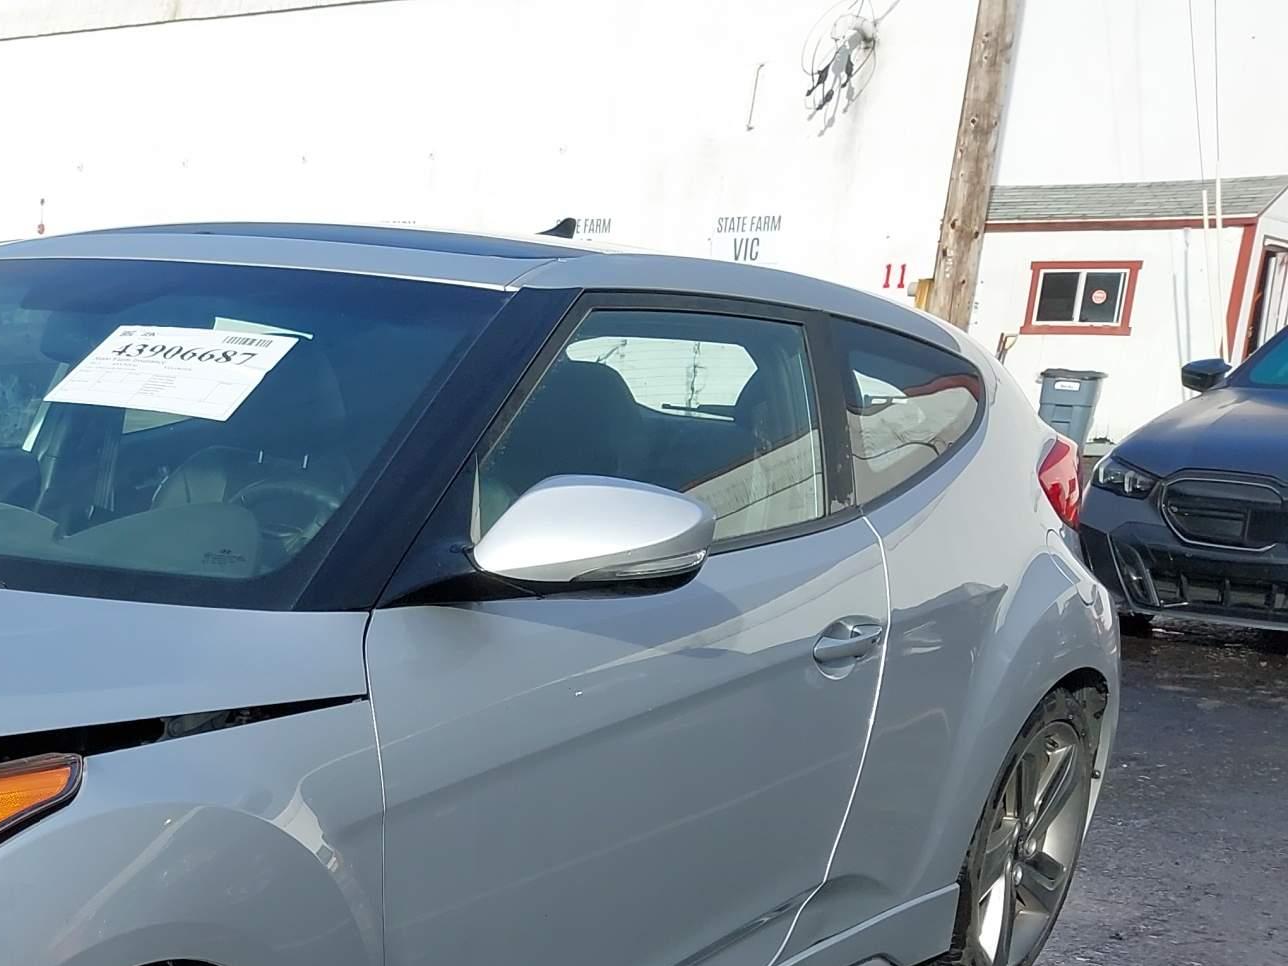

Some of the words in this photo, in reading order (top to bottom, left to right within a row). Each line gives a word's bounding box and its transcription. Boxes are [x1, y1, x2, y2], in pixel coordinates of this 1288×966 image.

[583, 218, 612, 234] FARM
[717, 216, 749, 233] STATE
[750, 215, 782, 232] FARM
[733, 238, 760, 261] VIC
[882, 263, 907, 288] 11
[112, 343, 257, 366] 43906687
